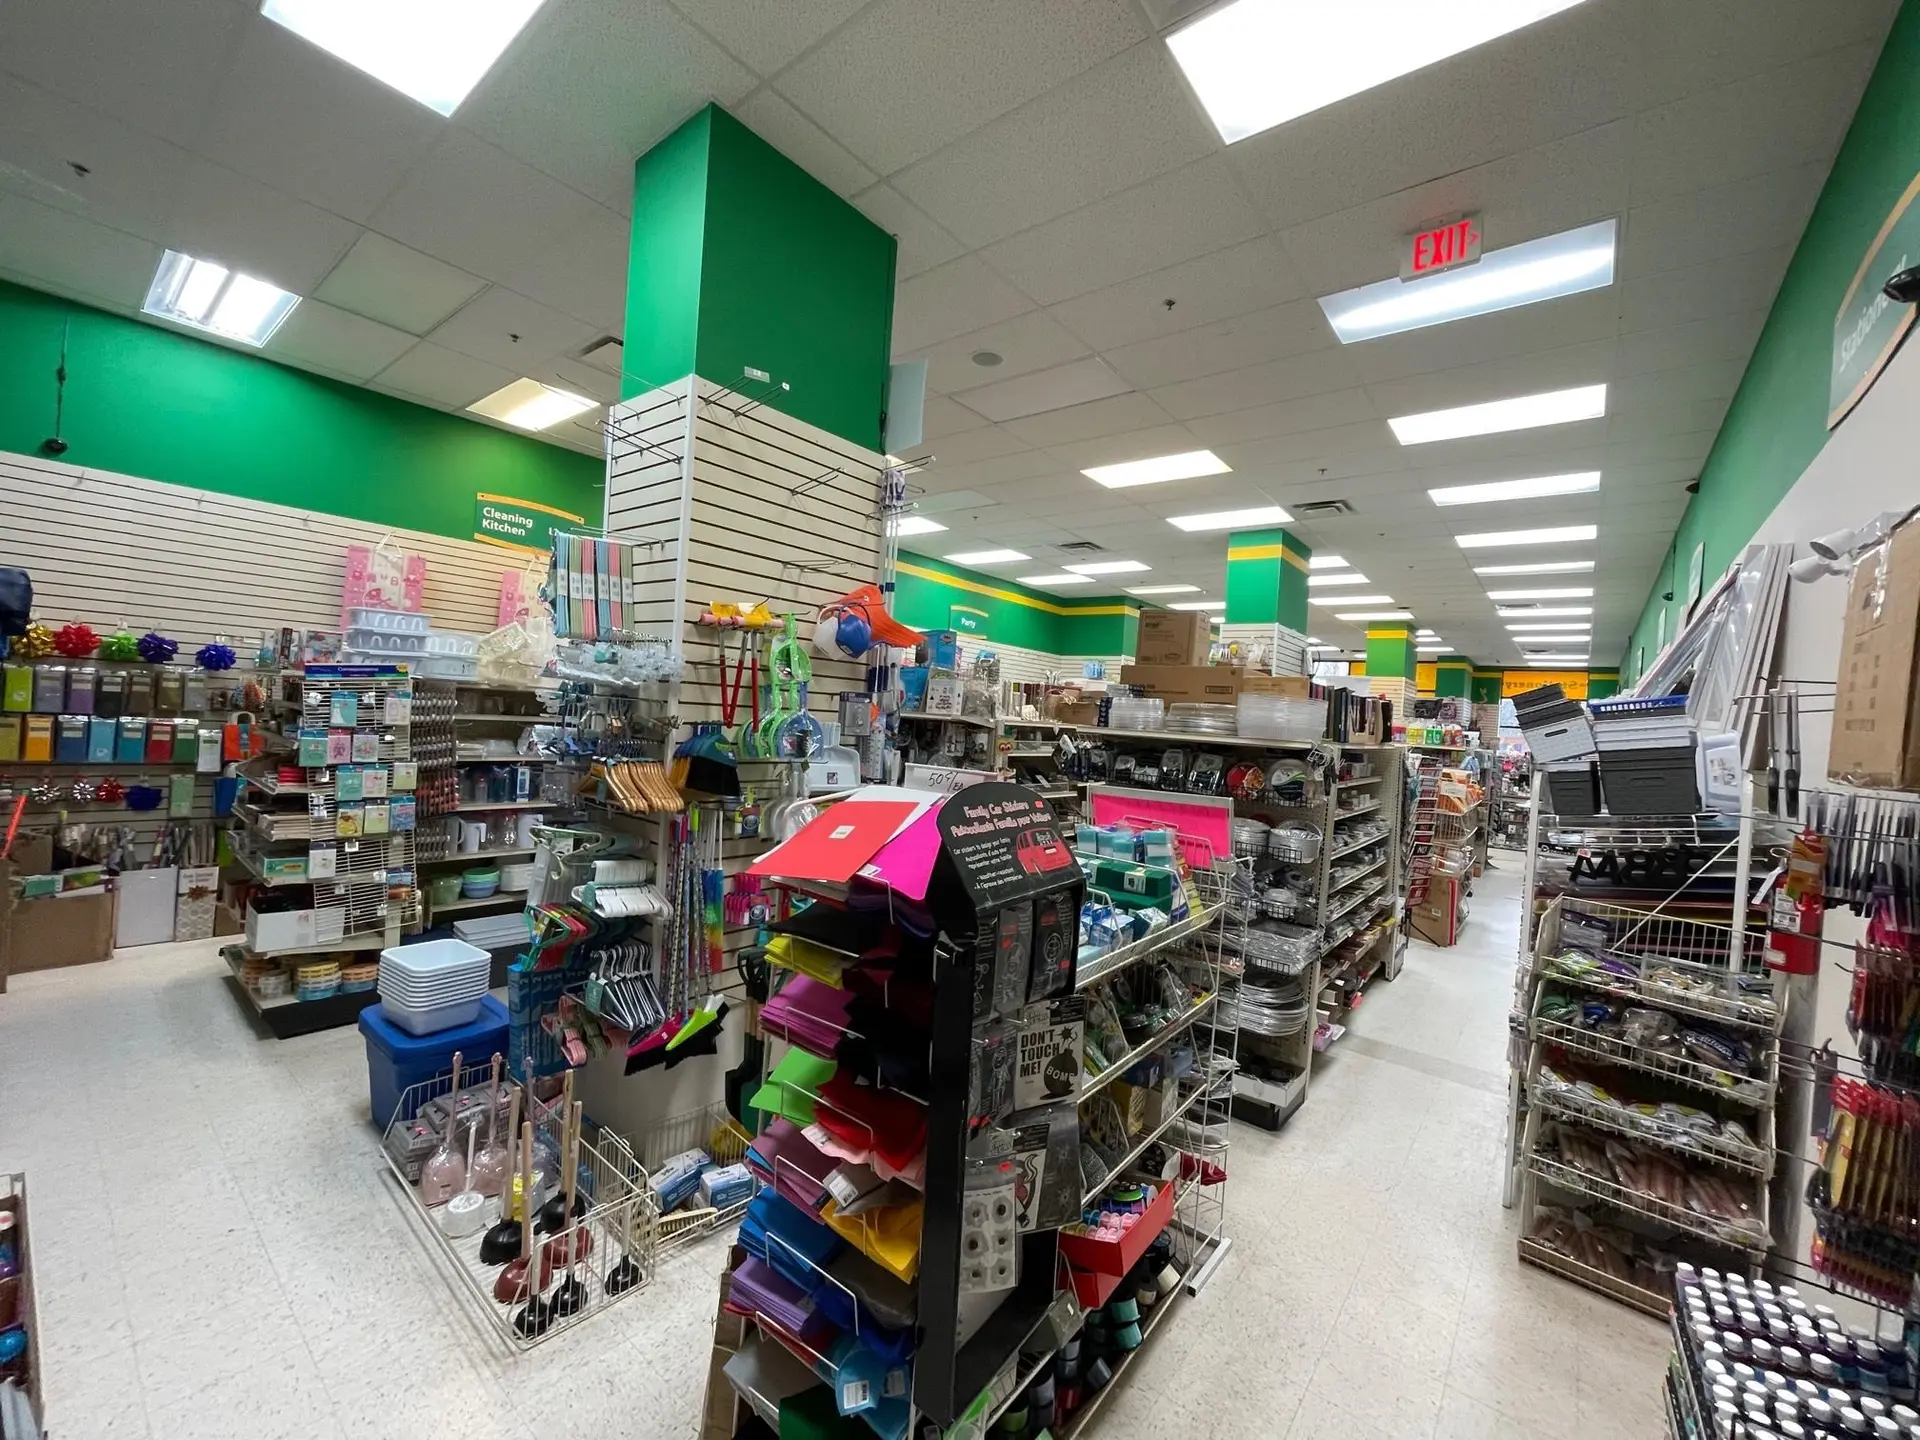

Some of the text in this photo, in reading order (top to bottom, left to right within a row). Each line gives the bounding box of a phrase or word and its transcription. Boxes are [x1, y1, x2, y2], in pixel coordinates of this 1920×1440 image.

[1413, 219, 1471, 272] EXIT
[482, 518, 526, 536] Kitchen
[483, 507, 533, 528] Cleaning
[961, 618, 976, 629] Party
[1021, 1029, 1055, 1048] DON'T
[1020, 1042, 1060, 1062] TOUCH
[1020, 1061, 1041, 1077] ME!
